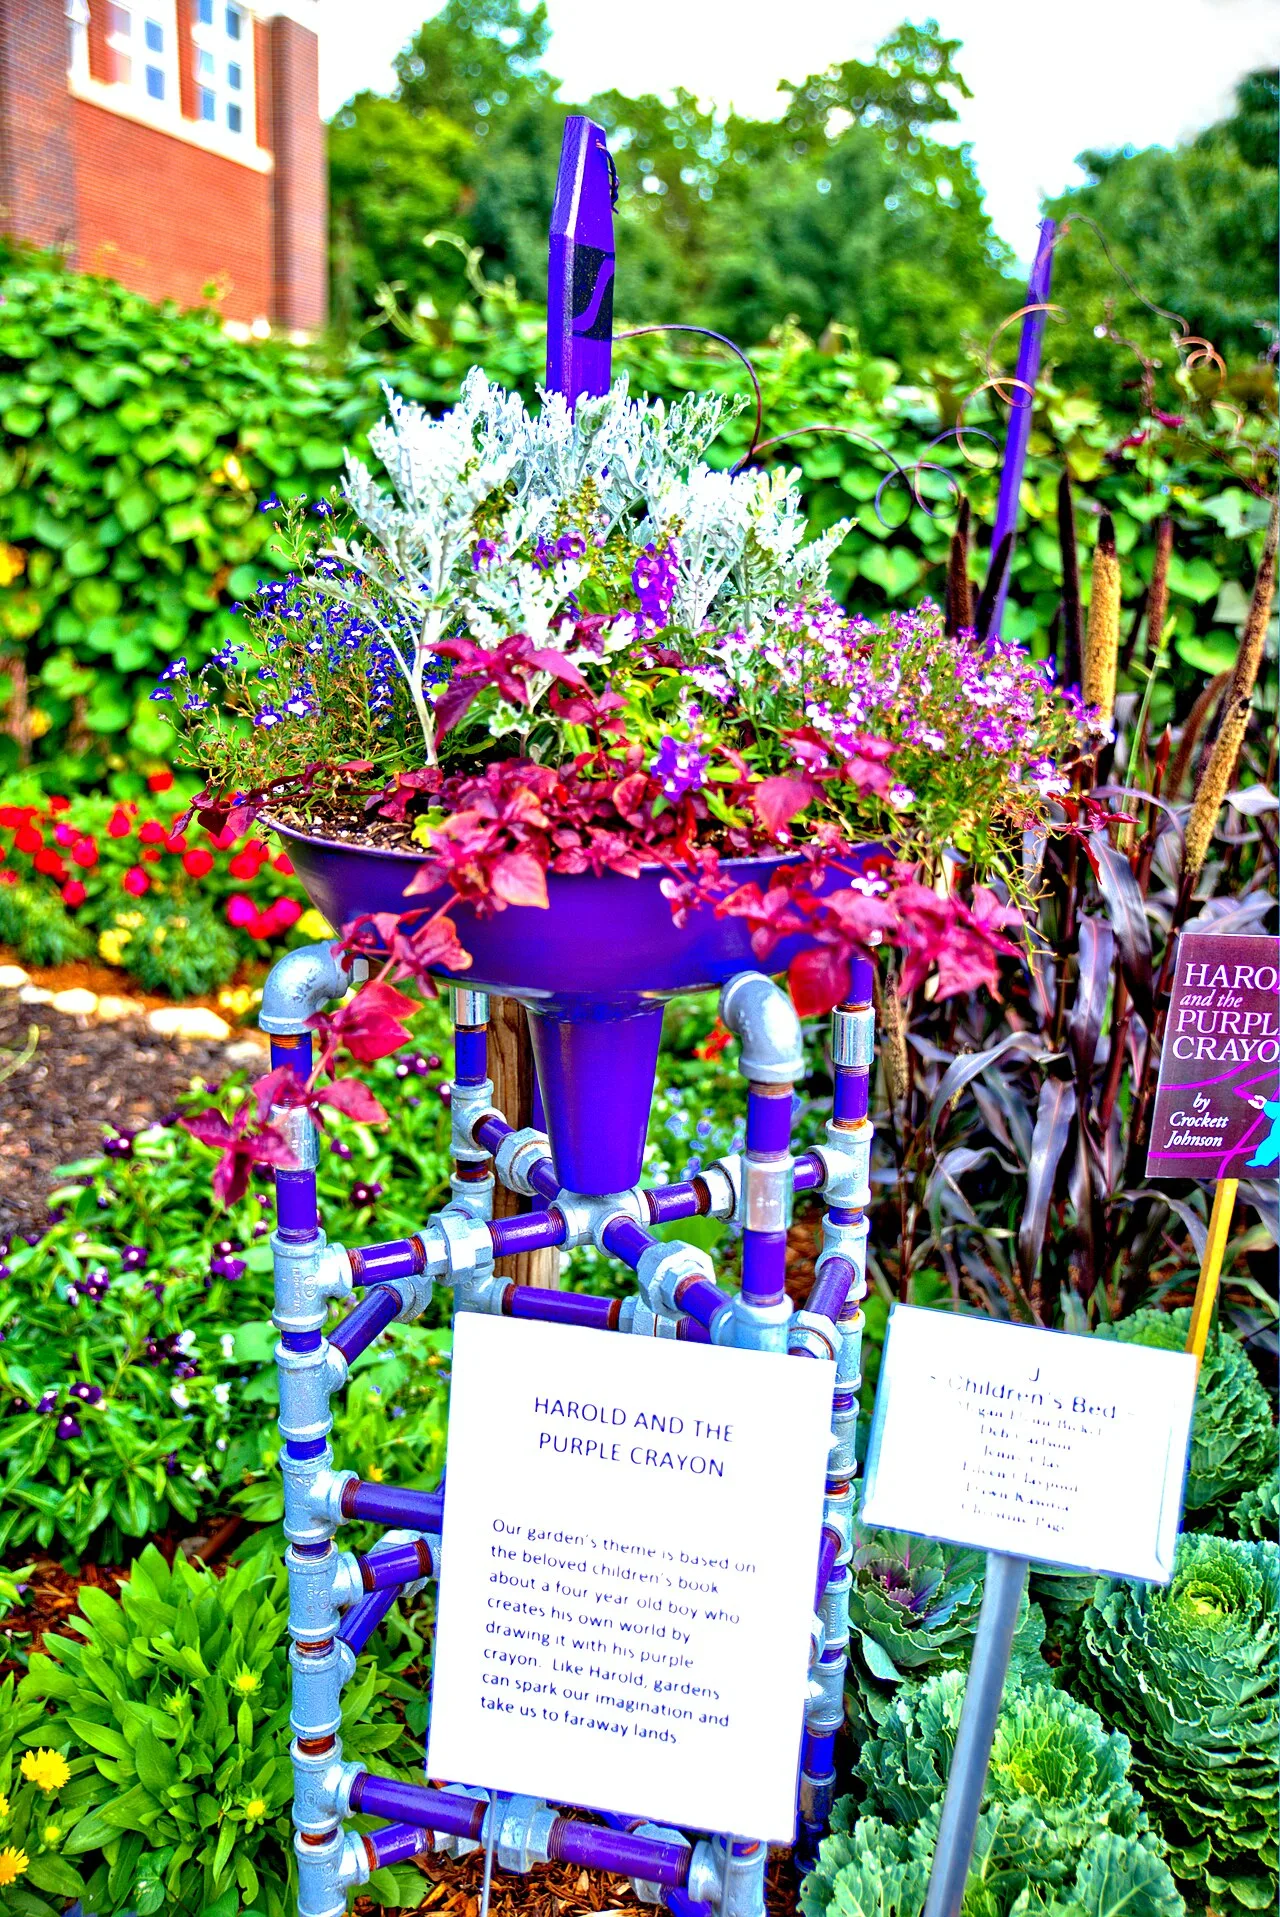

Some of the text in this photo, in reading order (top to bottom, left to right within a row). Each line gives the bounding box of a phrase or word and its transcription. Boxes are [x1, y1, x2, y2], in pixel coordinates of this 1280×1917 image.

[1182, 962, 1280, 991] HARO
[1180, 989, 1244, 1009] and the
[1175, 1009, 1280, 1036] PURPL
[1172, 1036, 1280, 1063] CRAYO
[1169, 1111, 1229, 1128] Crockett
[1192, 1092, 1211, 1113] by
[1163, 1129, 1223, 1149] Johnson
[534, 1396, 733, 1443] HAROLD AND THE
[1072, 1396, 1116, 1419] Bed
[539, 1431, 724, 1478] PURPLE CRAYON
[492, 1518, 756, 1573] Our garden's theme is based on
[490, 1544, 719, 1594] the beloved children's book
[489, 1570, 740, 1624] about a four year old boy who
[487, 1597, 691, 1645] creates his own world by
[485, 1620, 694, 1669] drawing it with his purple
[483, 1647, 720, 1701] crayon. Like Harold, gardens
[480, 1696, 515, 1714] take
[519, 1705, 537, 1718] us
[542, 1707, 559, 1722] to
[564, 1710, 629, 1738] faraway
[482, 1672, 729, 1728] can spark our imagination and
